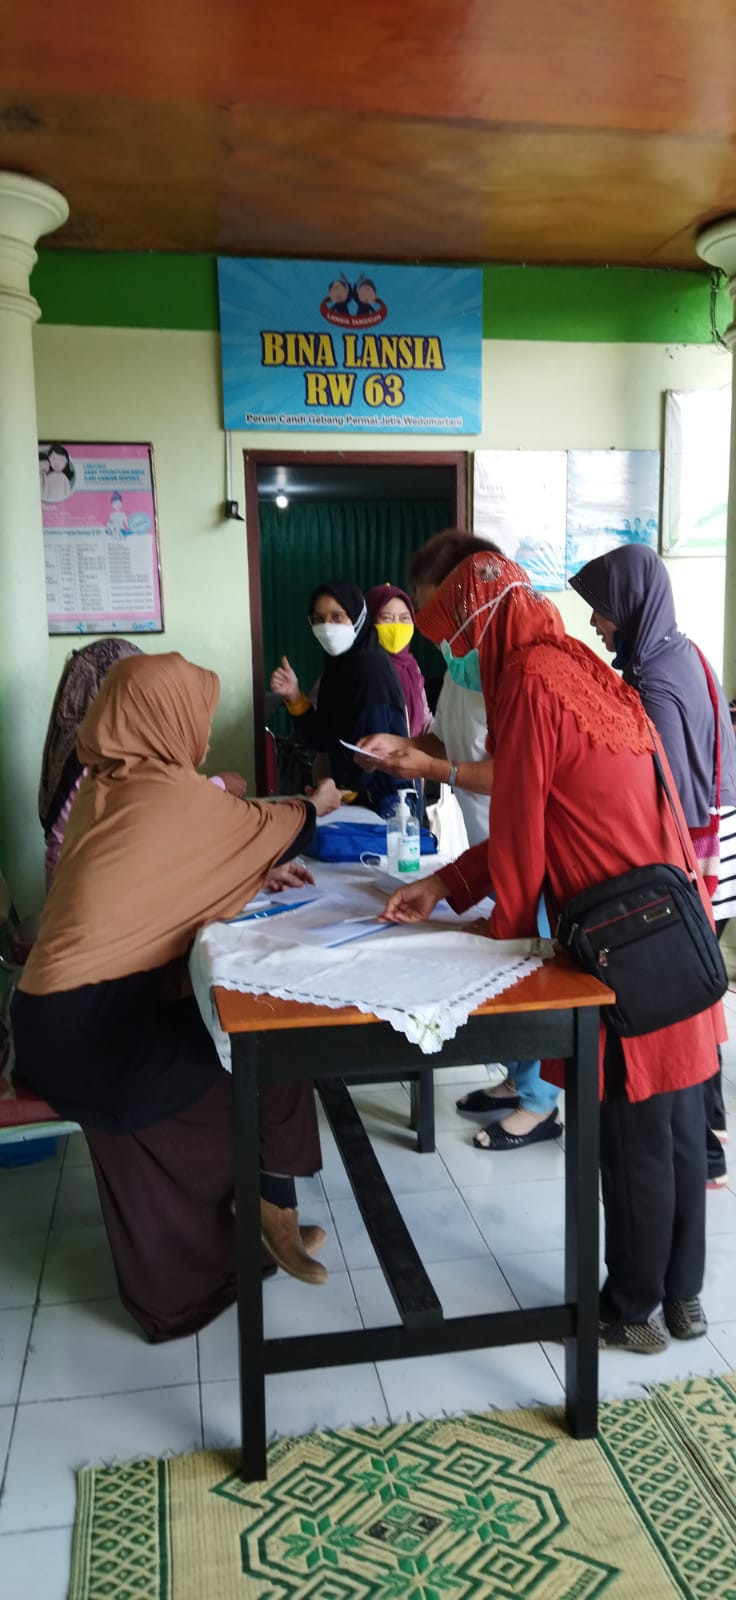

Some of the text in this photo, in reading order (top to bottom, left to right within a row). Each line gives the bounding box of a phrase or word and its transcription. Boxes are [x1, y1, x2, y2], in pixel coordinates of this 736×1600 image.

[262, 332, 445, 370] BINA LANSIA
[306, 373, 404, 407] RW 63
[246, 412, 277, 424] Perum
